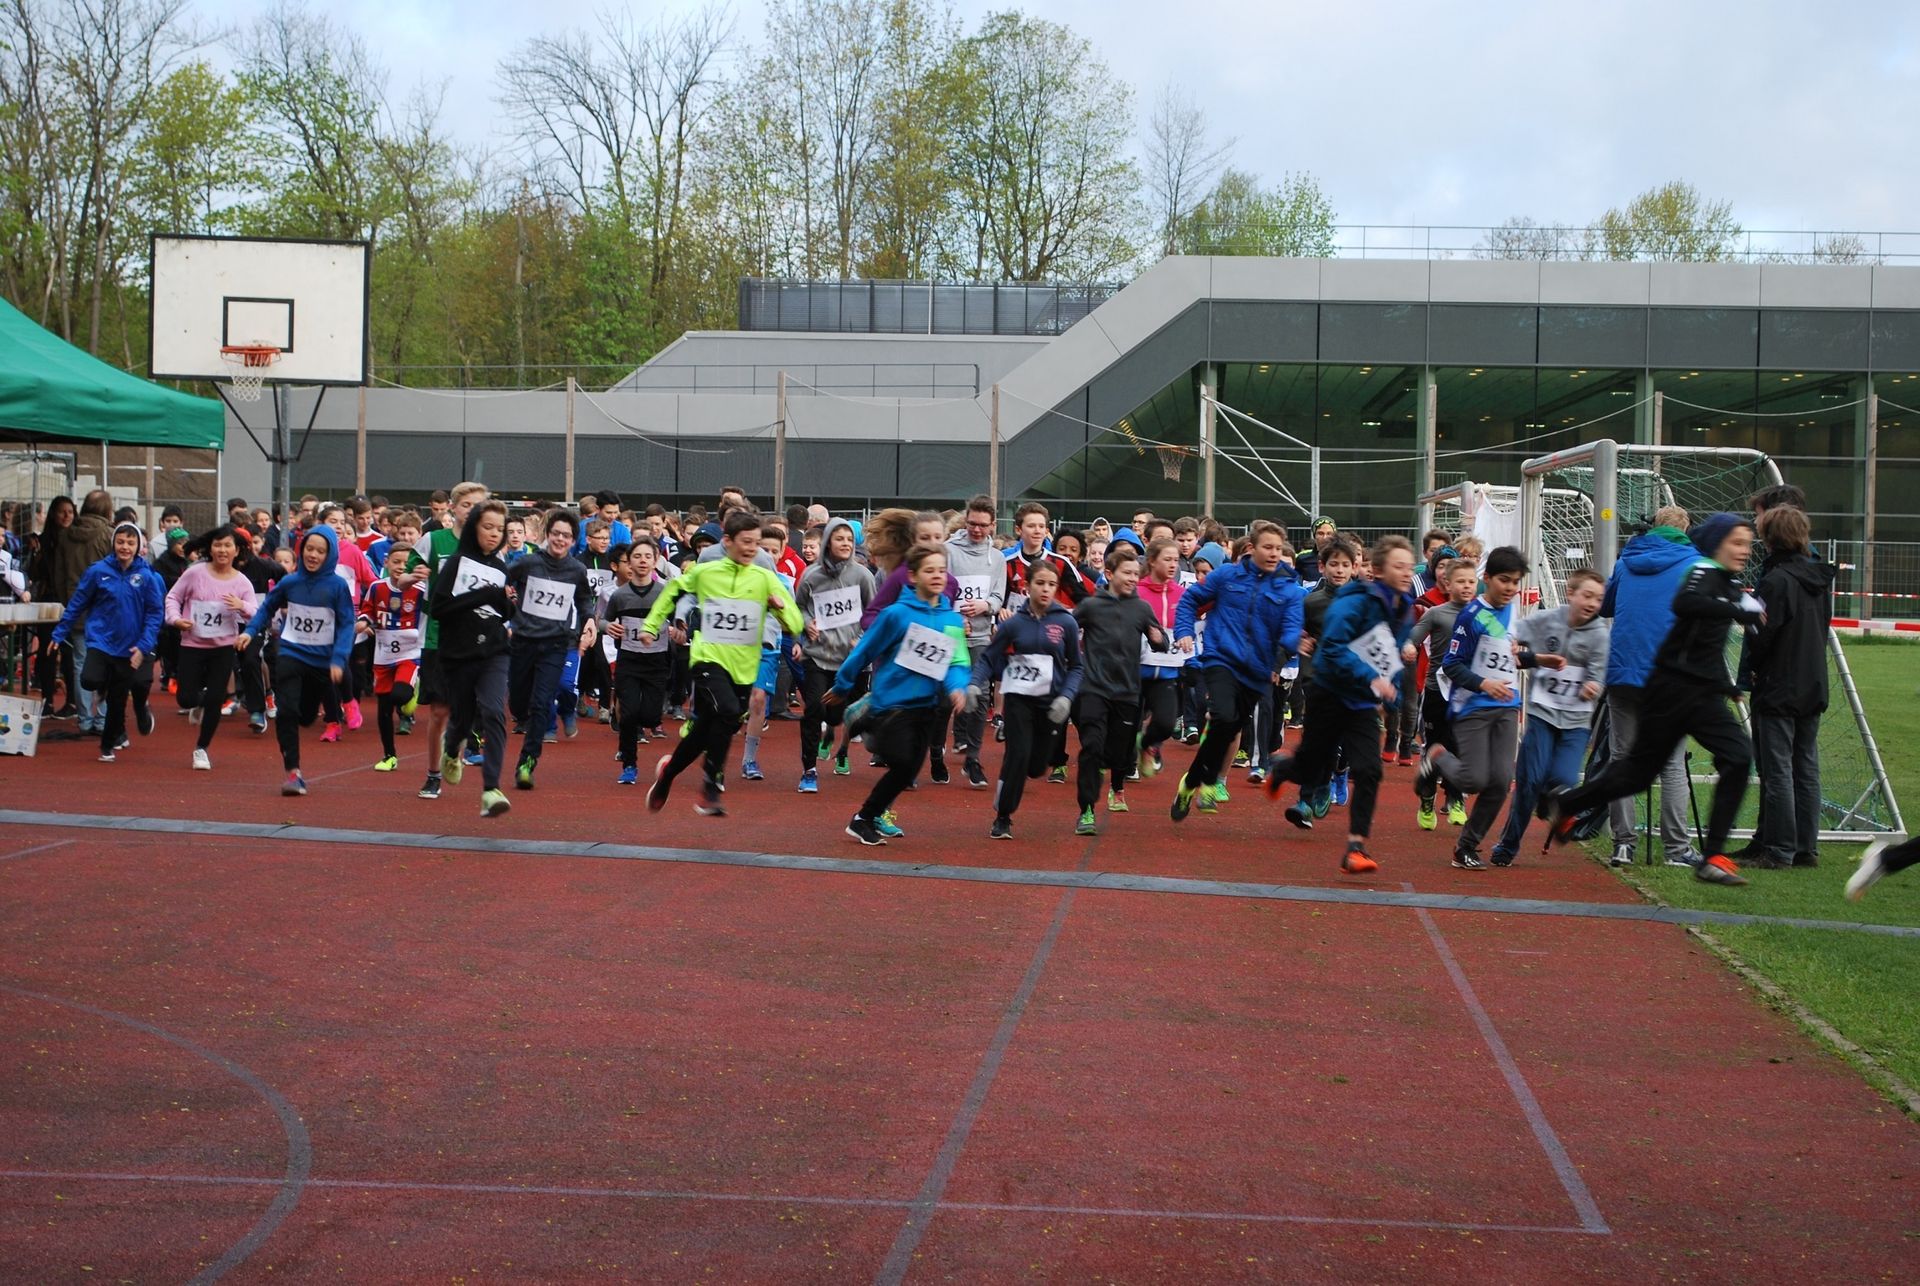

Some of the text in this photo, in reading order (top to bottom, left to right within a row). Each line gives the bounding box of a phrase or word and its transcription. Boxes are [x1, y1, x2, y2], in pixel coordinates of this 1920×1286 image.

[534, 590, 564, 608] 274
[955, 586, 982, 600] 281
[825, 599, 852, 617] 284
[203, 612, 222, 626] 24
[294, 616, 324, 633] 287
[713, 611, 749, 631] 291
[390, 640, 400, 653] 8
